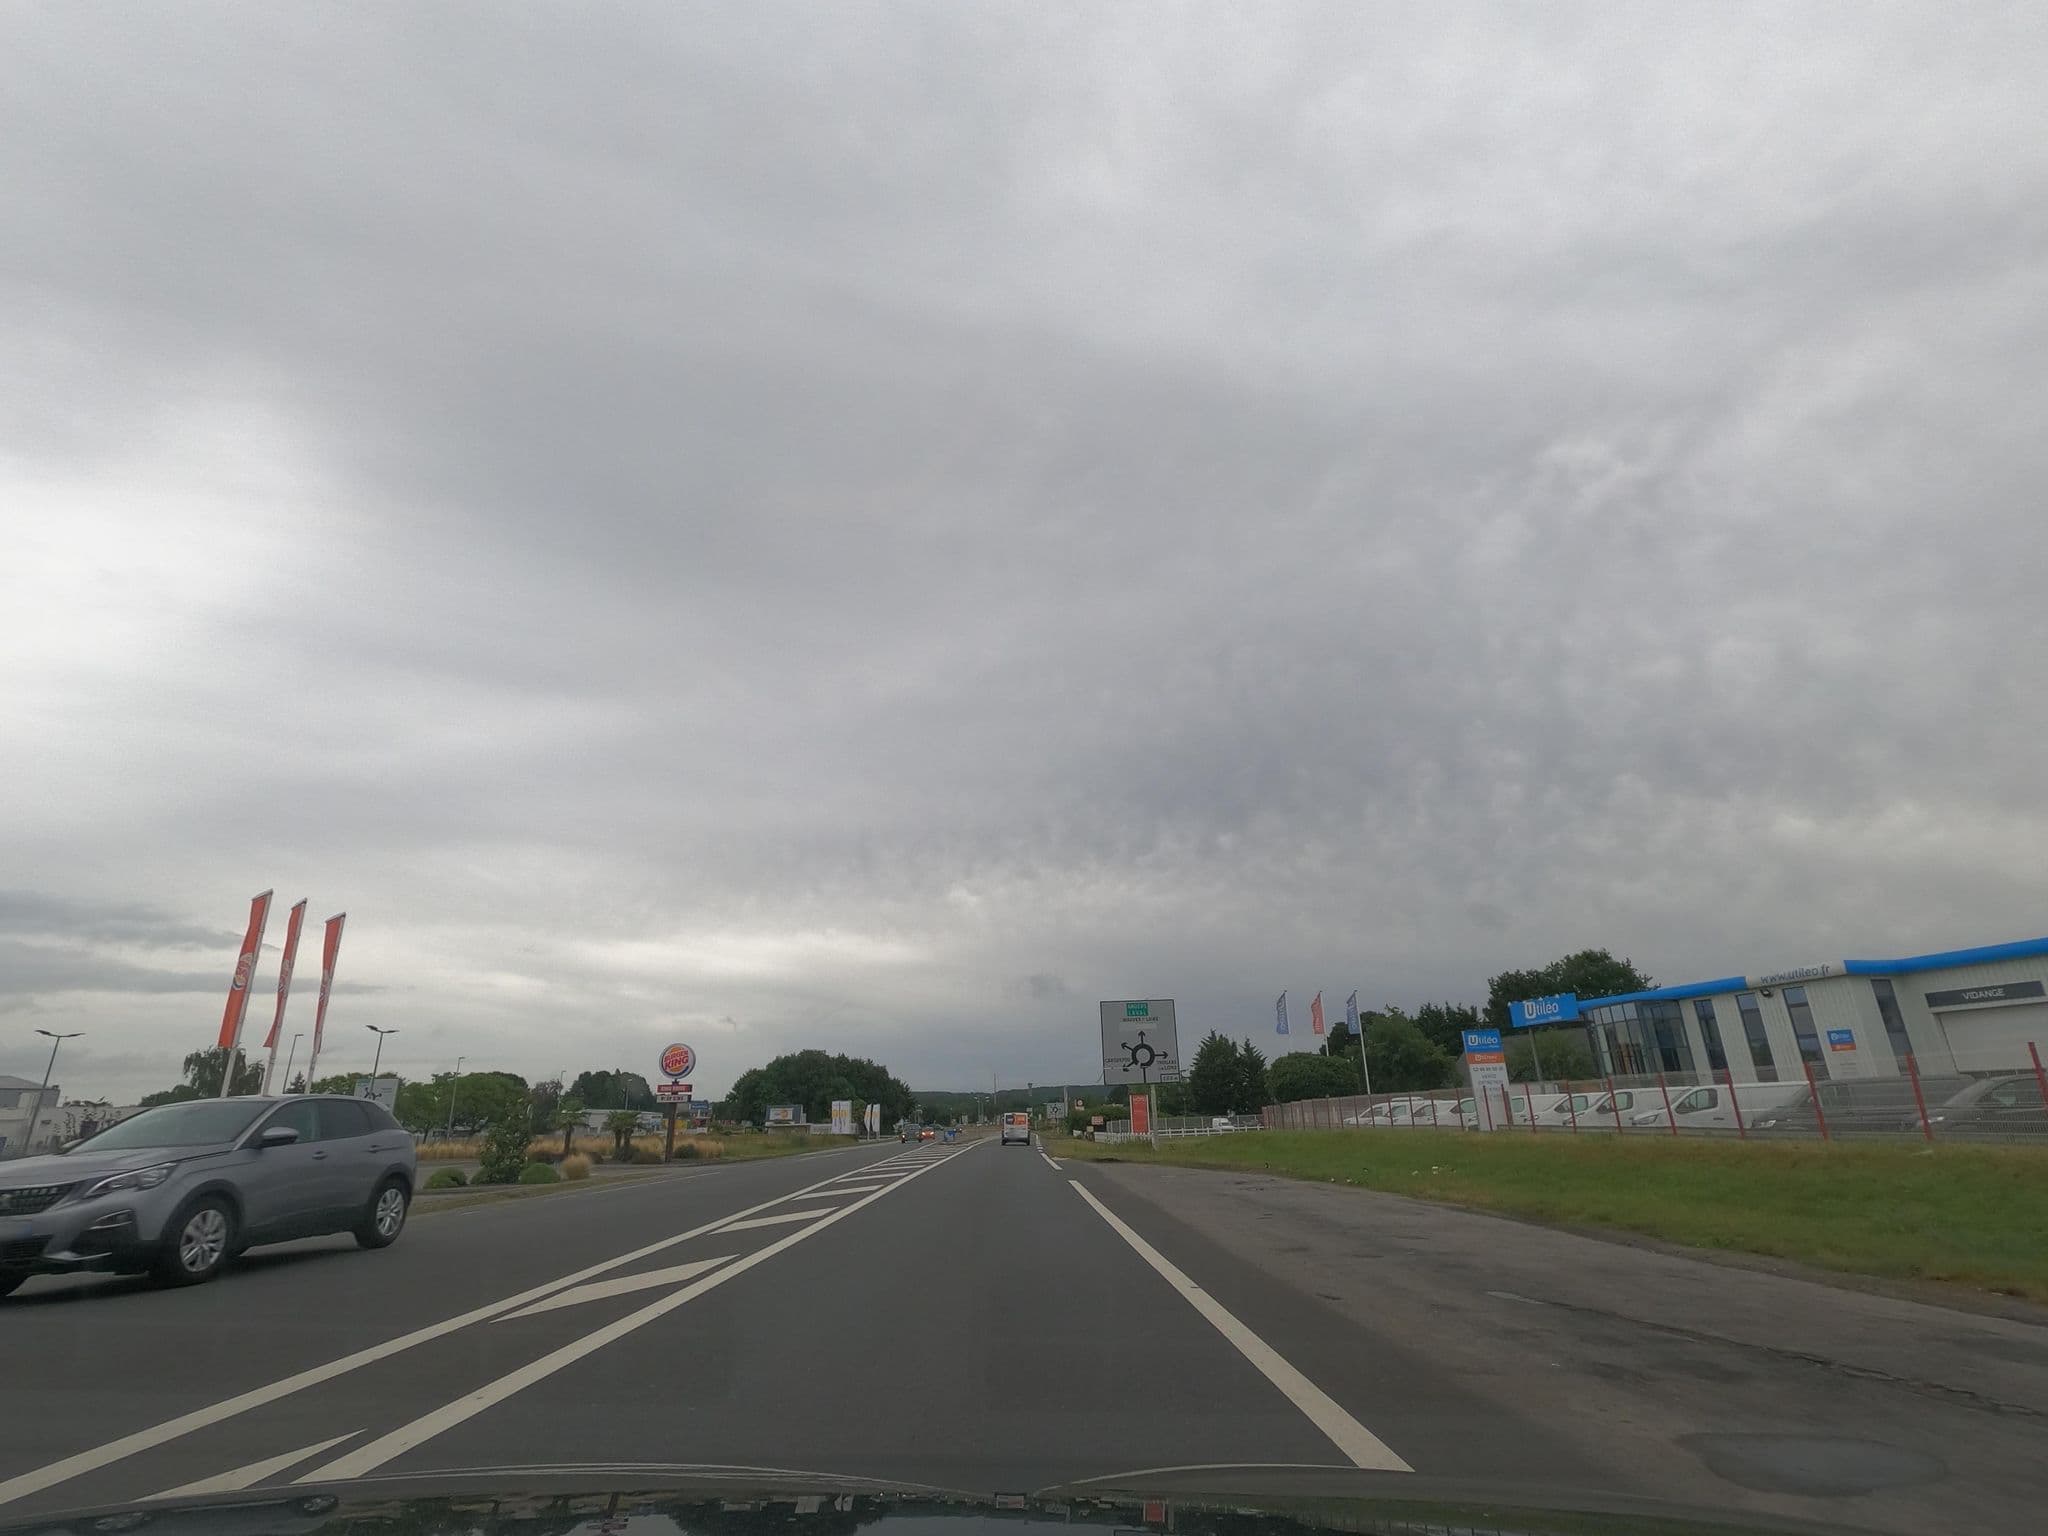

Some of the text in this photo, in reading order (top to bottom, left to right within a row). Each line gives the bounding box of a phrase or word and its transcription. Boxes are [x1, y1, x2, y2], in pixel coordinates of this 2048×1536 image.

[1962, 988, 2006, 1000] VIDANGE
[664, 1050, 689, 1062] BURGER
[664, 1056, 689, 1070] KING
